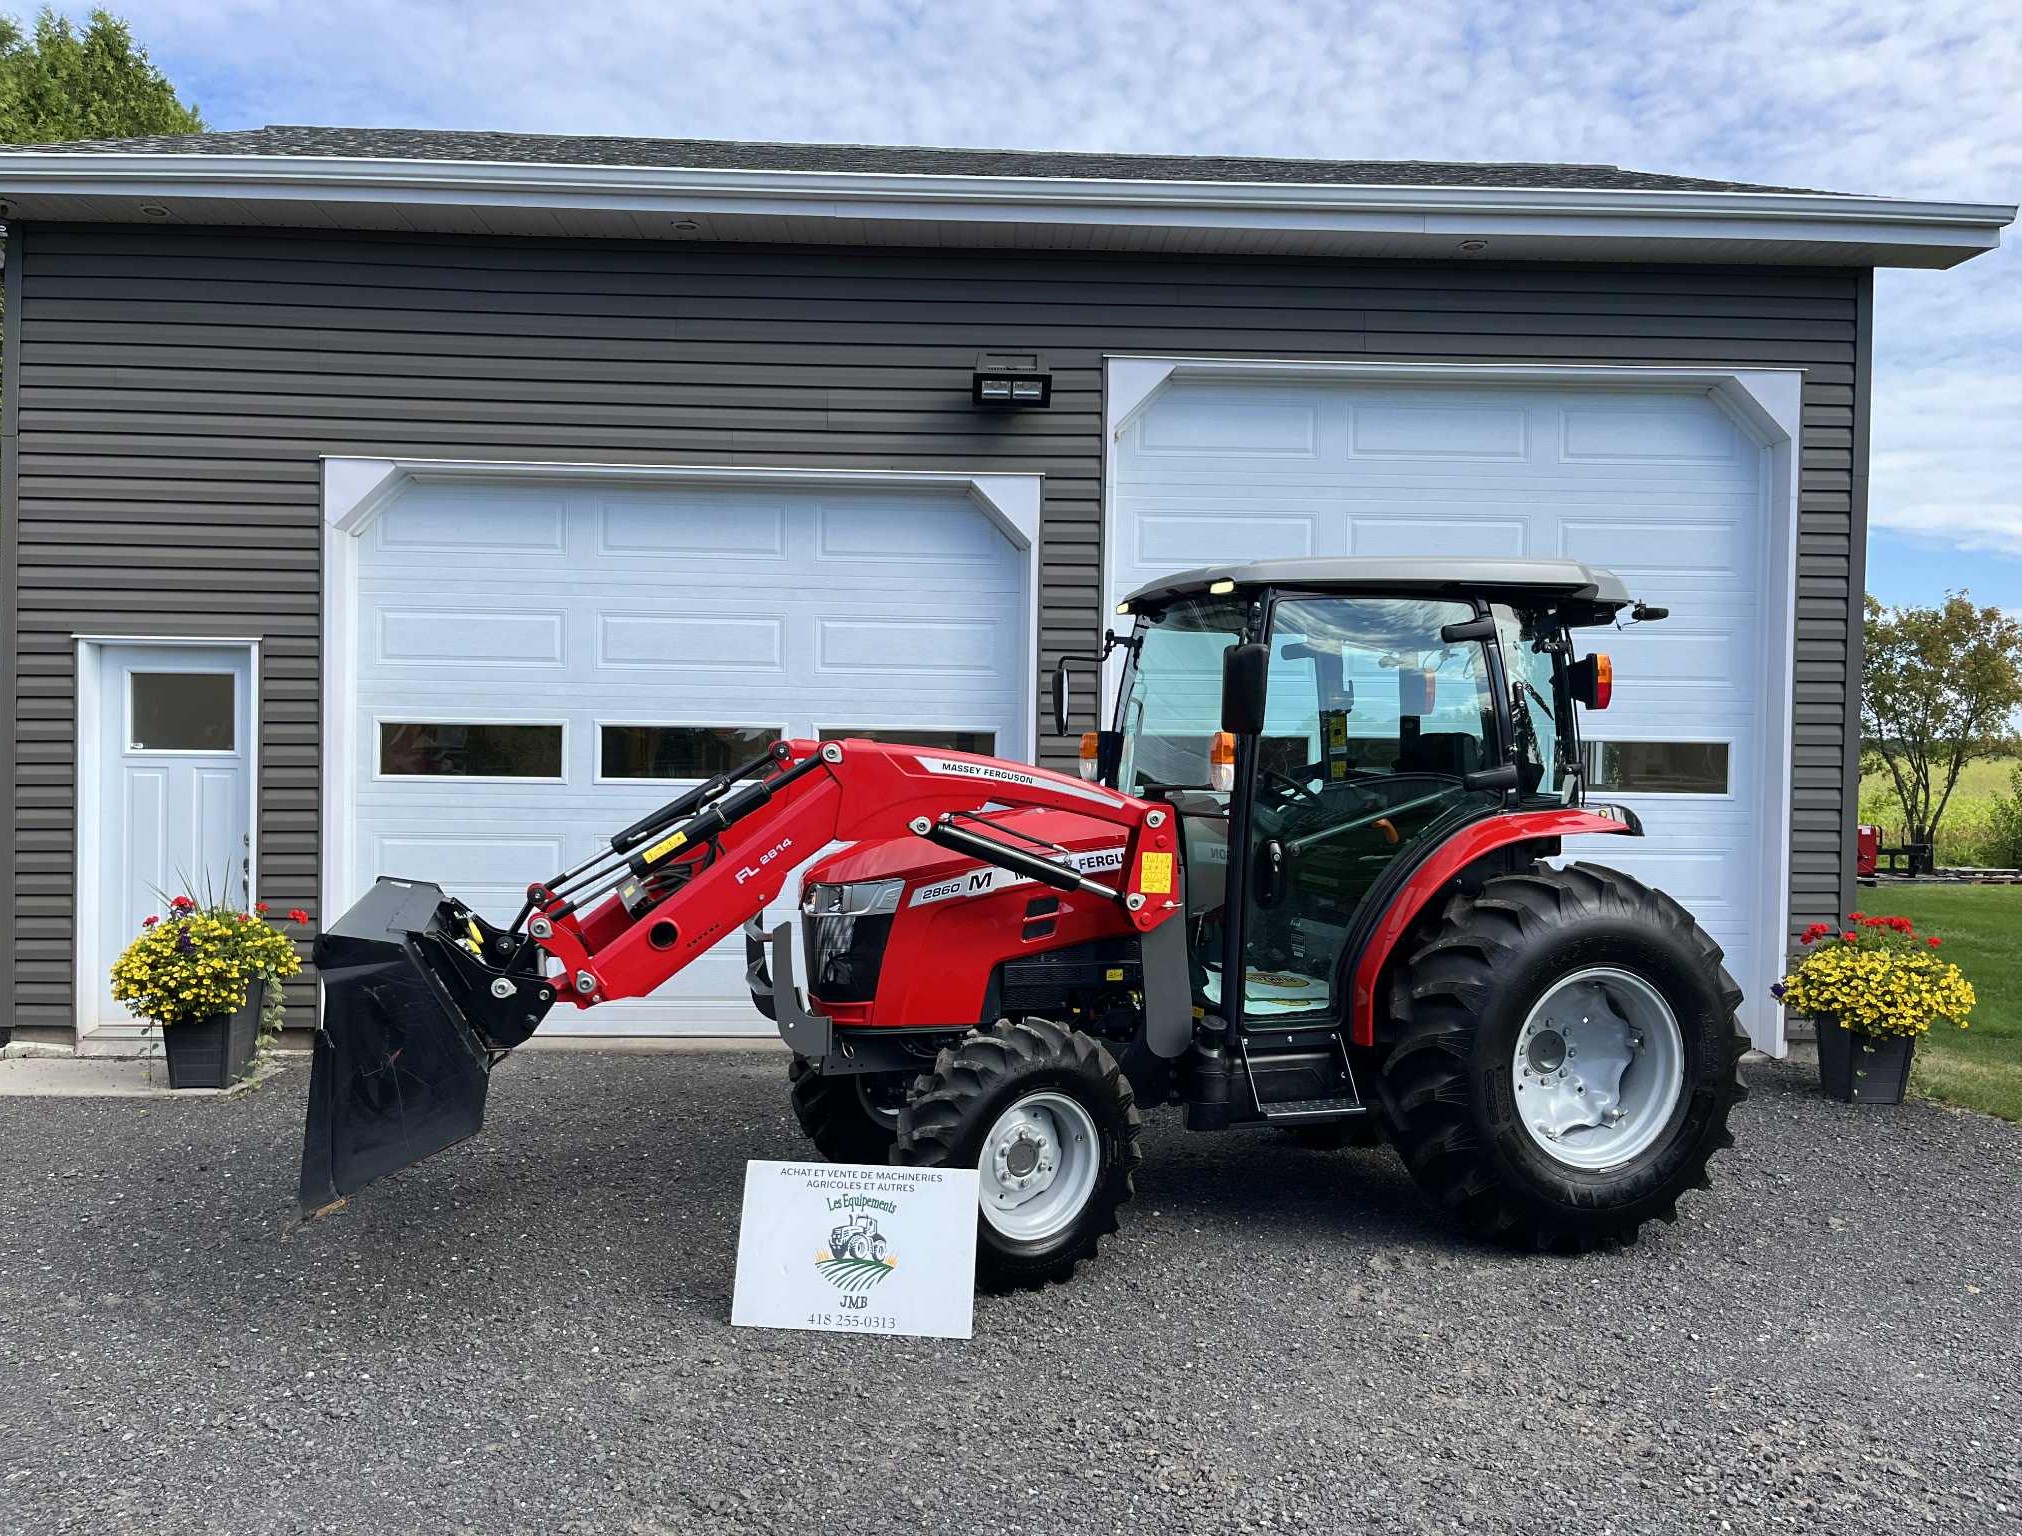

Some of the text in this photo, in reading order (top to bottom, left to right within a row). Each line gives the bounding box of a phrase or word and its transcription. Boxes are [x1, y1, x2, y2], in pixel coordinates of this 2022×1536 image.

[942, 763, 1034, 785] MASSEY FERGUSON
[735, 838, 792, 884] FL 2814
[922, 883, 961, 900] 2860
[968, 871, 993, 891] M
[780, 1167, 943, 1183] ACHAT ET VENTE DE MACHINERIES
[806, 1180, 915, 1192] AGRICOLES ET AUTRES
[826, 1193, 897, 1214] Les Equipements
[839, 1295, 868, 1309] JMB
[806, 1312, 896, 1329] 418 255-0313
